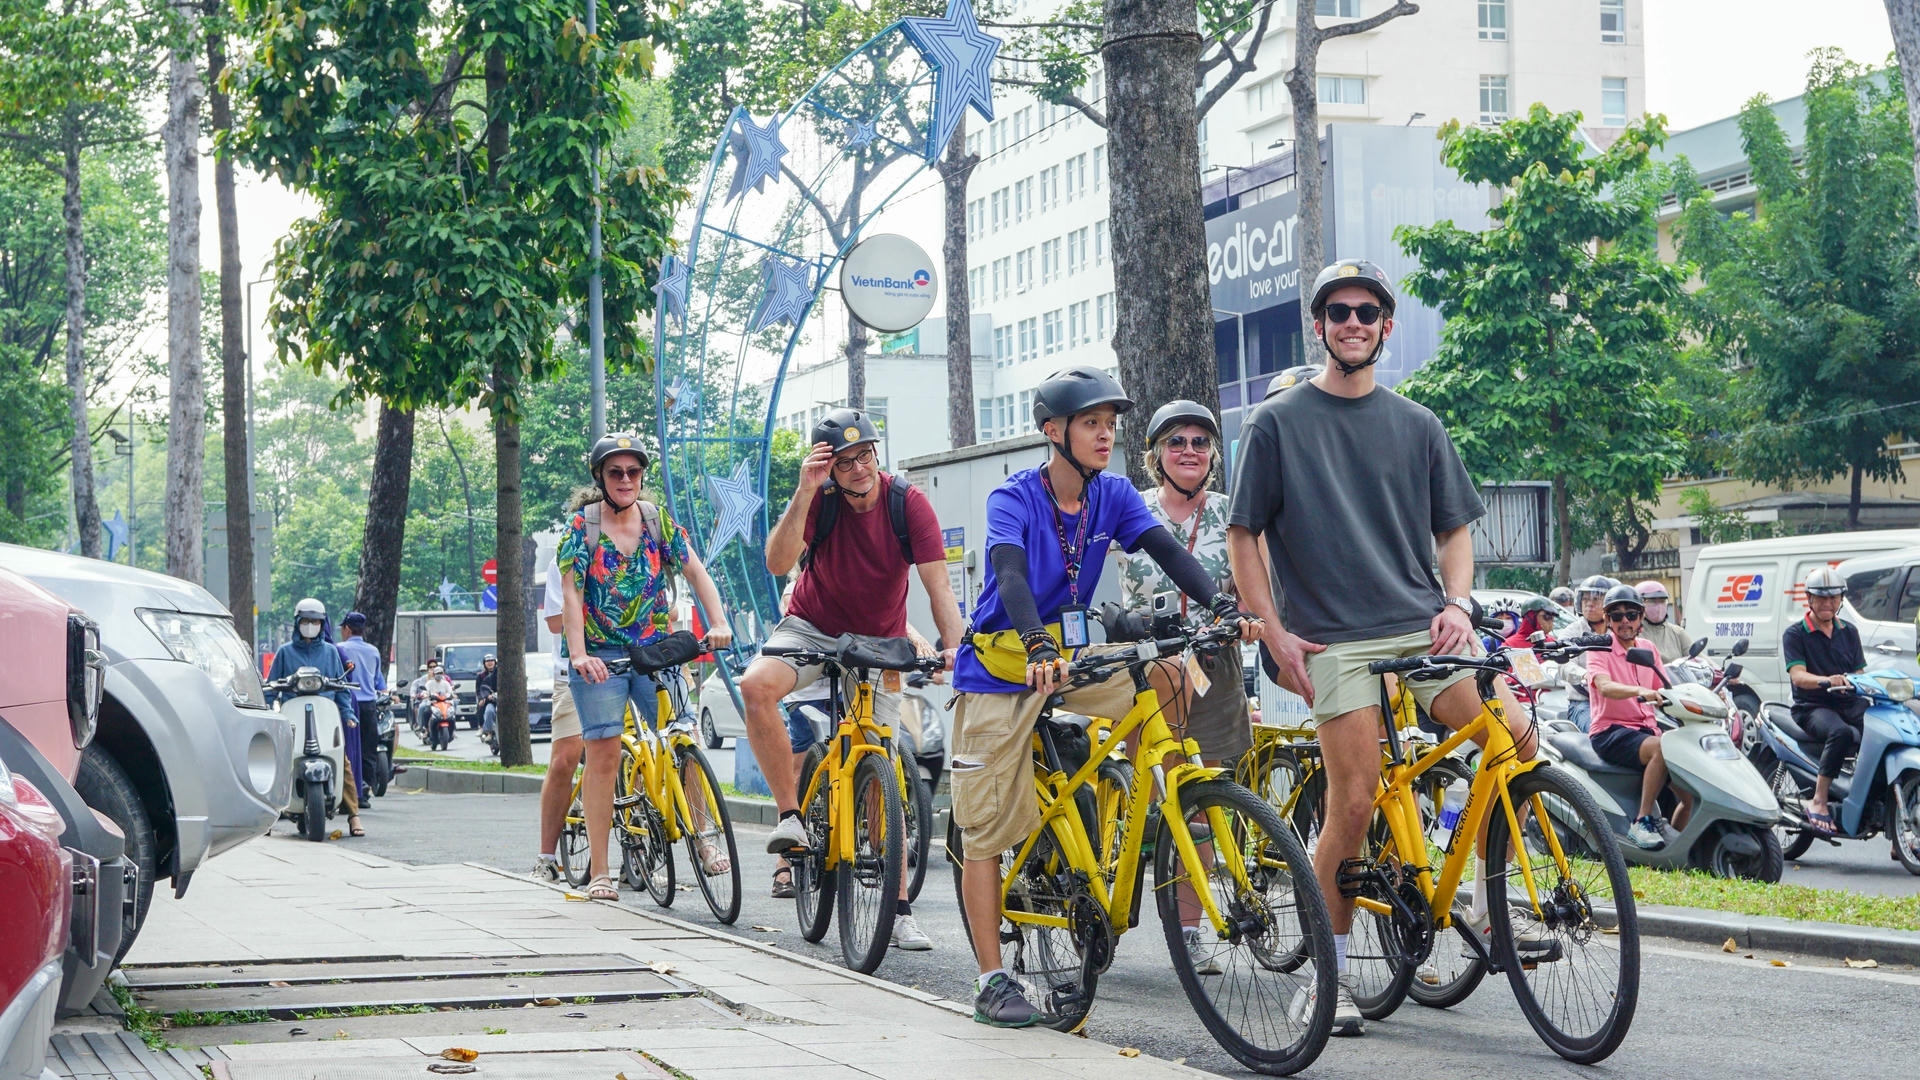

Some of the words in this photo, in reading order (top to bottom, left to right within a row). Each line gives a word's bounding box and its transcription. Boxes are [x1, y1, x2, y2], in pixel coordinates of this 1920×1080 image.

[1207, 213, 1299, 286] edicar
[851, 275, 915, 290] VietinBank
[1249, 279, 1273, 300] love
[1274, 268, 1300, 297] your
[1715, 622, 1754, 637] 50H-338.31
